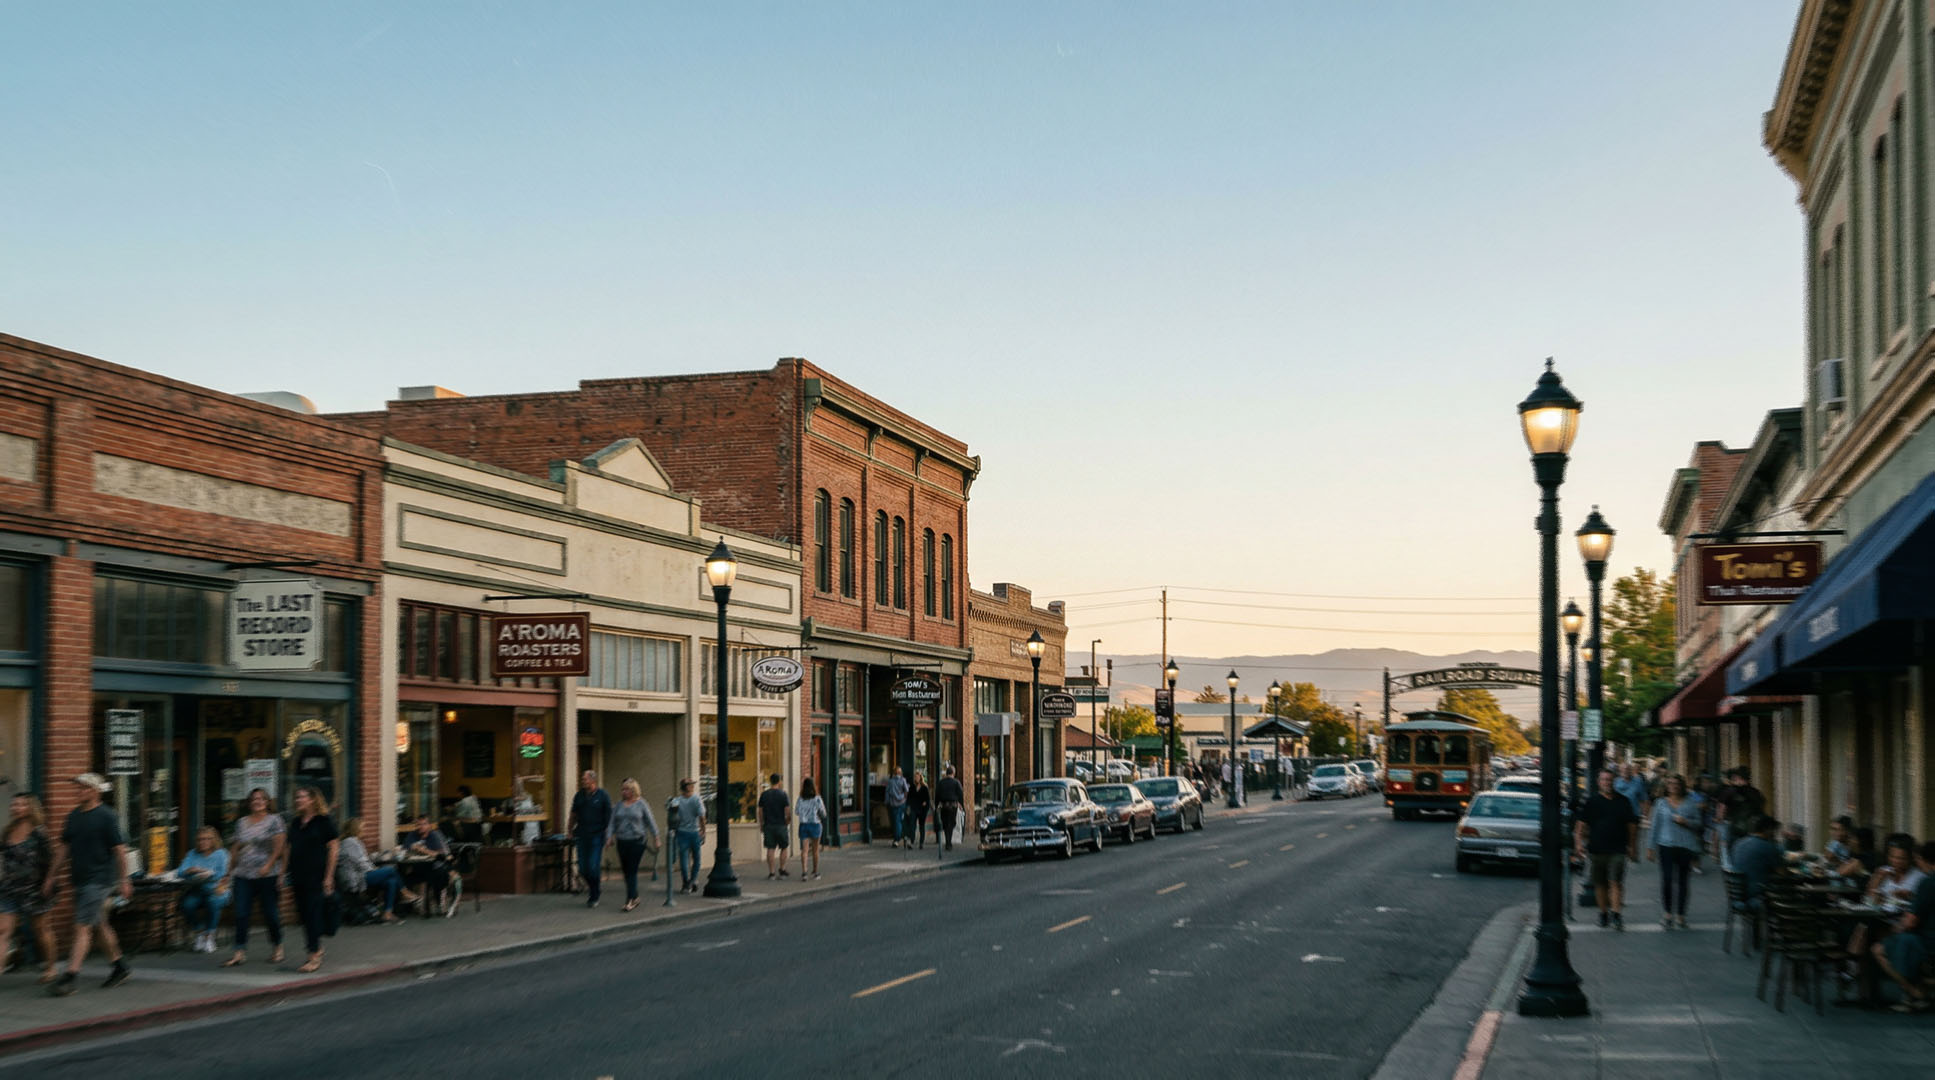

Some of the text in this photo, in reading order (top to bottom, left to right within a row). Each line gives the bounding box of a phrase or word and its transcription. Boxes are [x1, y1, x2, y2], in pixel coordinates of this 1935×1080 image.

[236, 594, 313, 612] The LAST
[237, 617, 313, 634] RECORD
[499, 624, 581, 640] A'ROMA
[243, 639, 306, 656] STORE
[498, 643, 582, 656] ROASTERS
[505, 660, 543, 668] COFFEE
[554, 659, 574, 667] TEA
[1415, 669, 1542, 685] RAILROAD SQUARE
